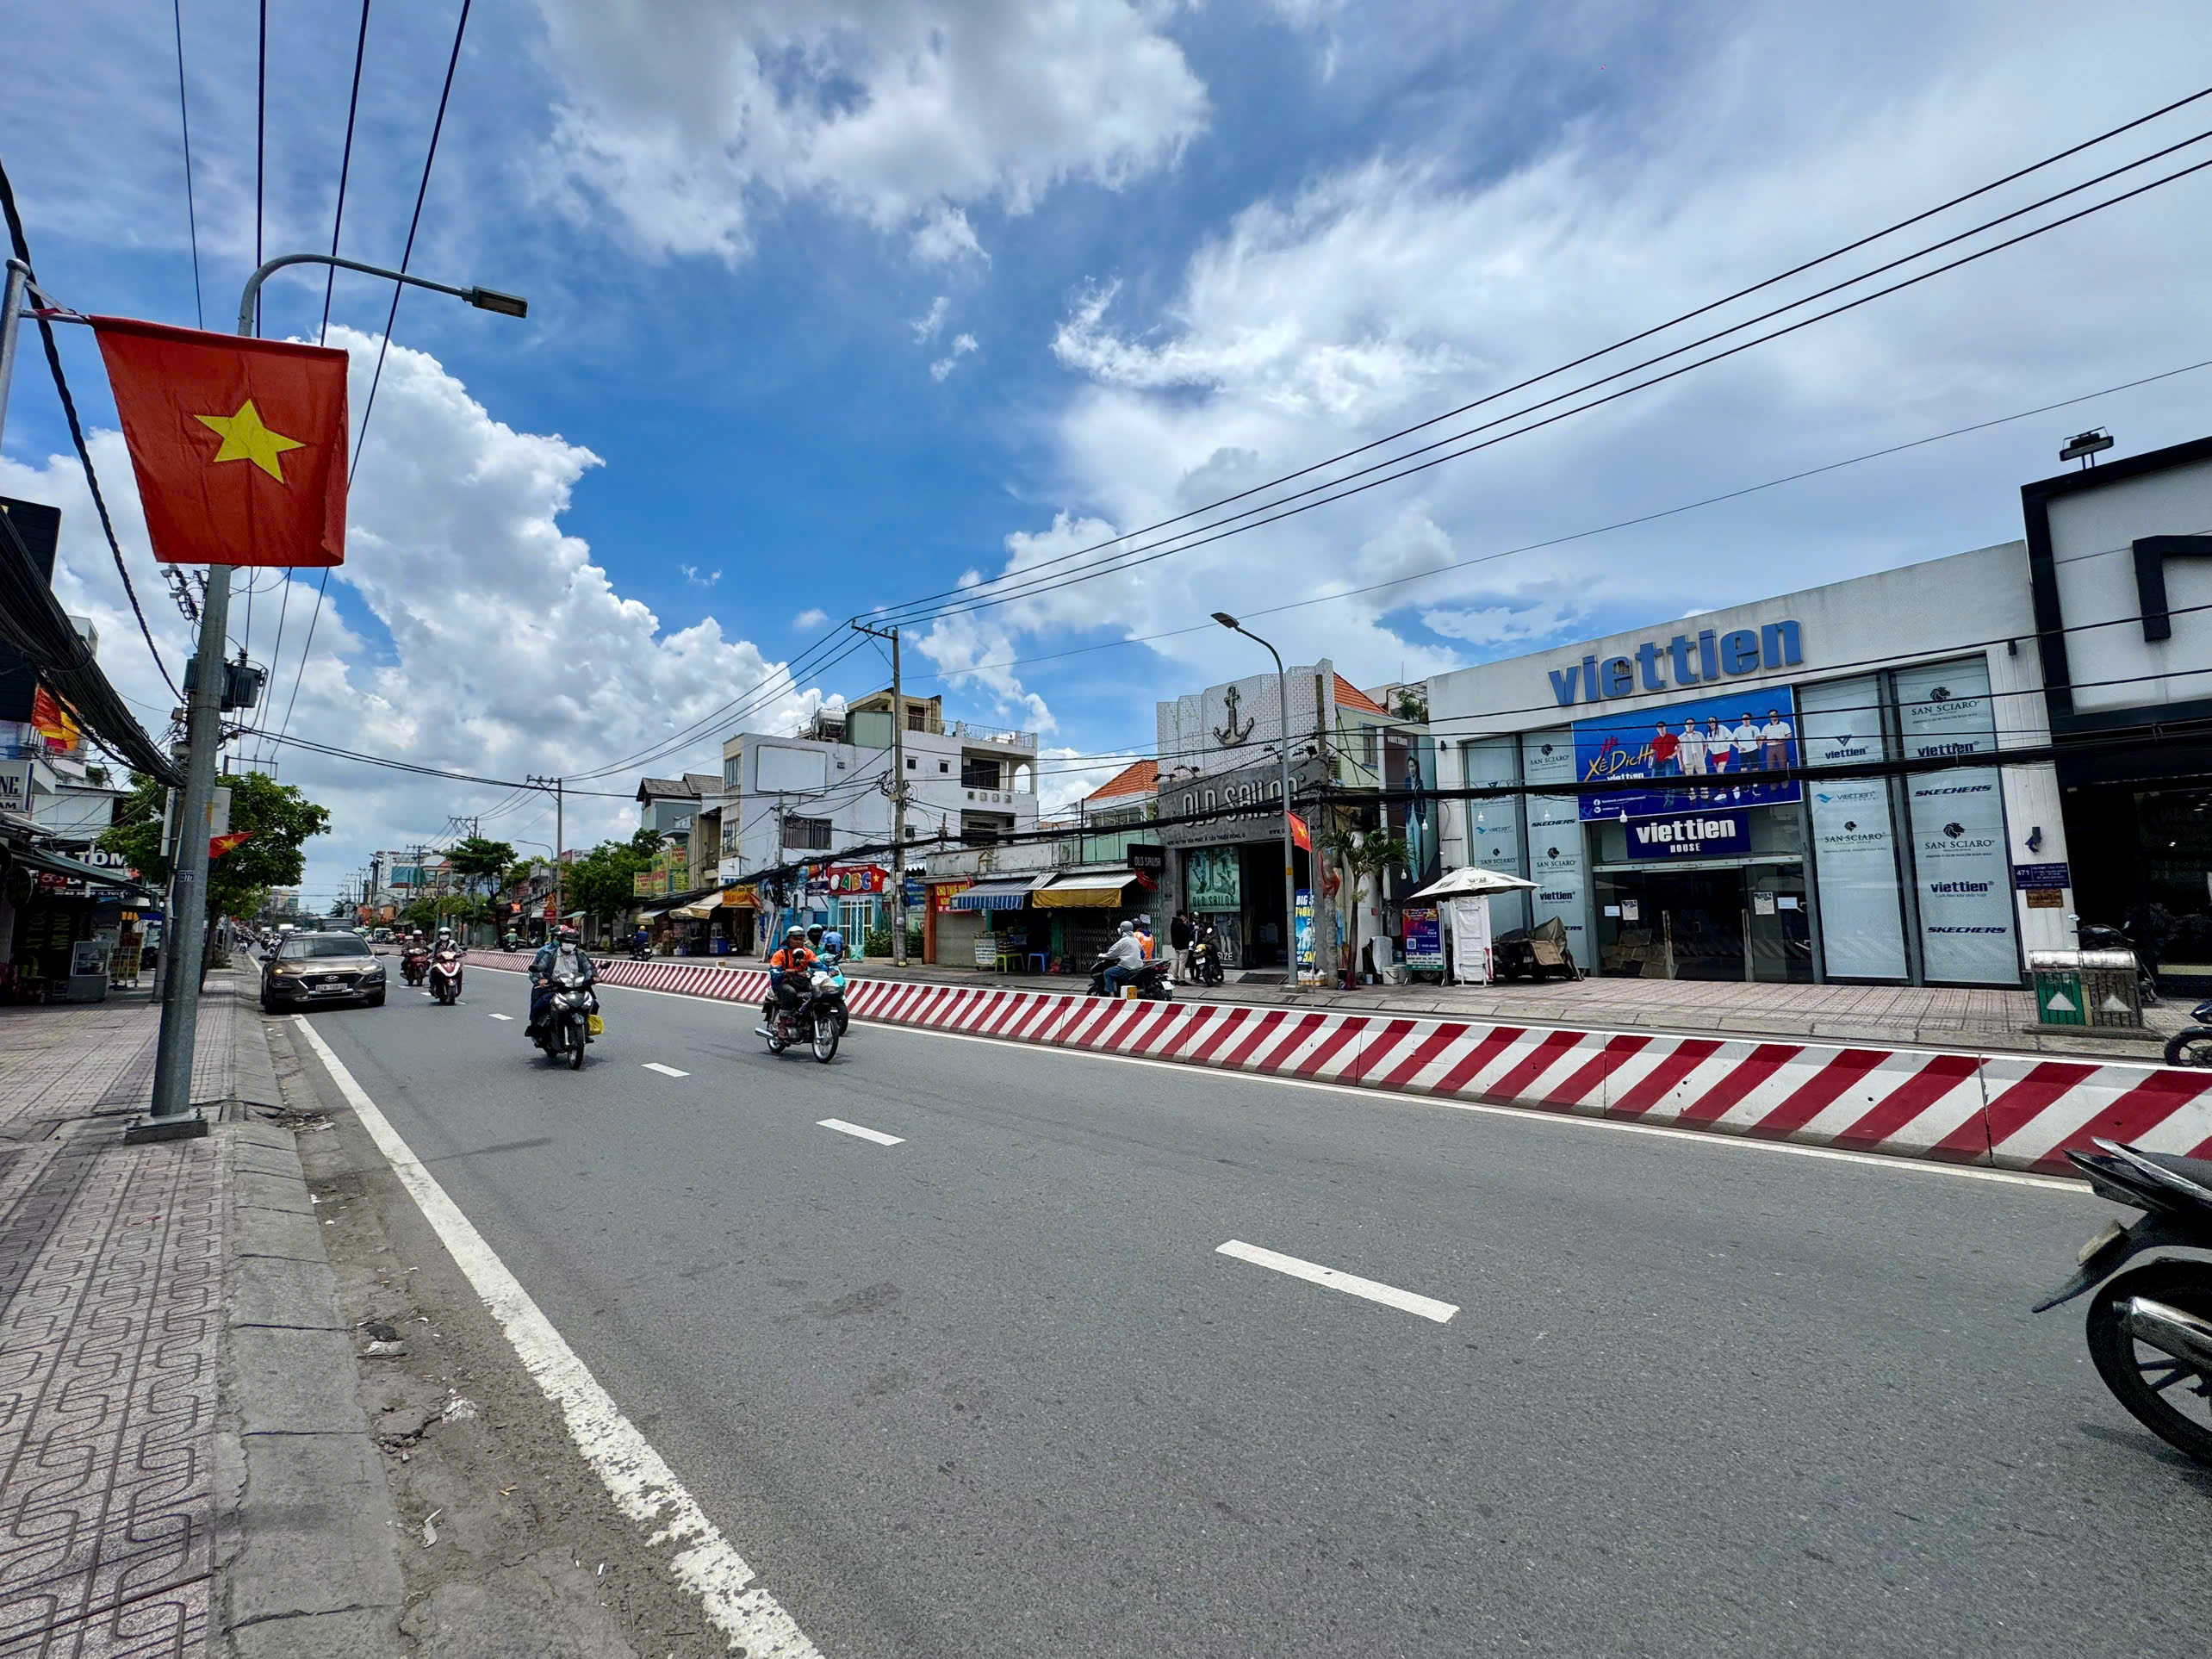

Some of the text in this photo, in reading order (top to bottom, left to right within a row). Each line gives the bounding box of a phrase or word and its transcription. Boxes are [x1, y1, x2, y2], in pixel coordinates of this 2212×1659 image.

[1548, 620, 1803, 706] viettien
[1911, 700, 1978, 716] SAN SCIARO
[1825, 747, 1867, 759] viettien
[1917, 743, 1974, 757] viettien
[1914, 784, 1992, 797] SKECHERS
[1532, 818, 1576, 827] SKECHERS
[1636, 818, 1737, 844] viettien
[1846, 833, 1882, 842] SCIARO
[1670, 842, 1701, 853] HOUSE
[1950, 840, 1992, 848] SCIARO
[1134, 855, 1161, 867] OLD SAILOR
[840, 871, 872, 892] ABC
[1929, 881, 1988, 892] viettien
[1192, 895, 1235, 907] OLD SAILOR
[1539, 892, 1573, 901] viettien
[1217, 951, 1233, 960] SIZE
